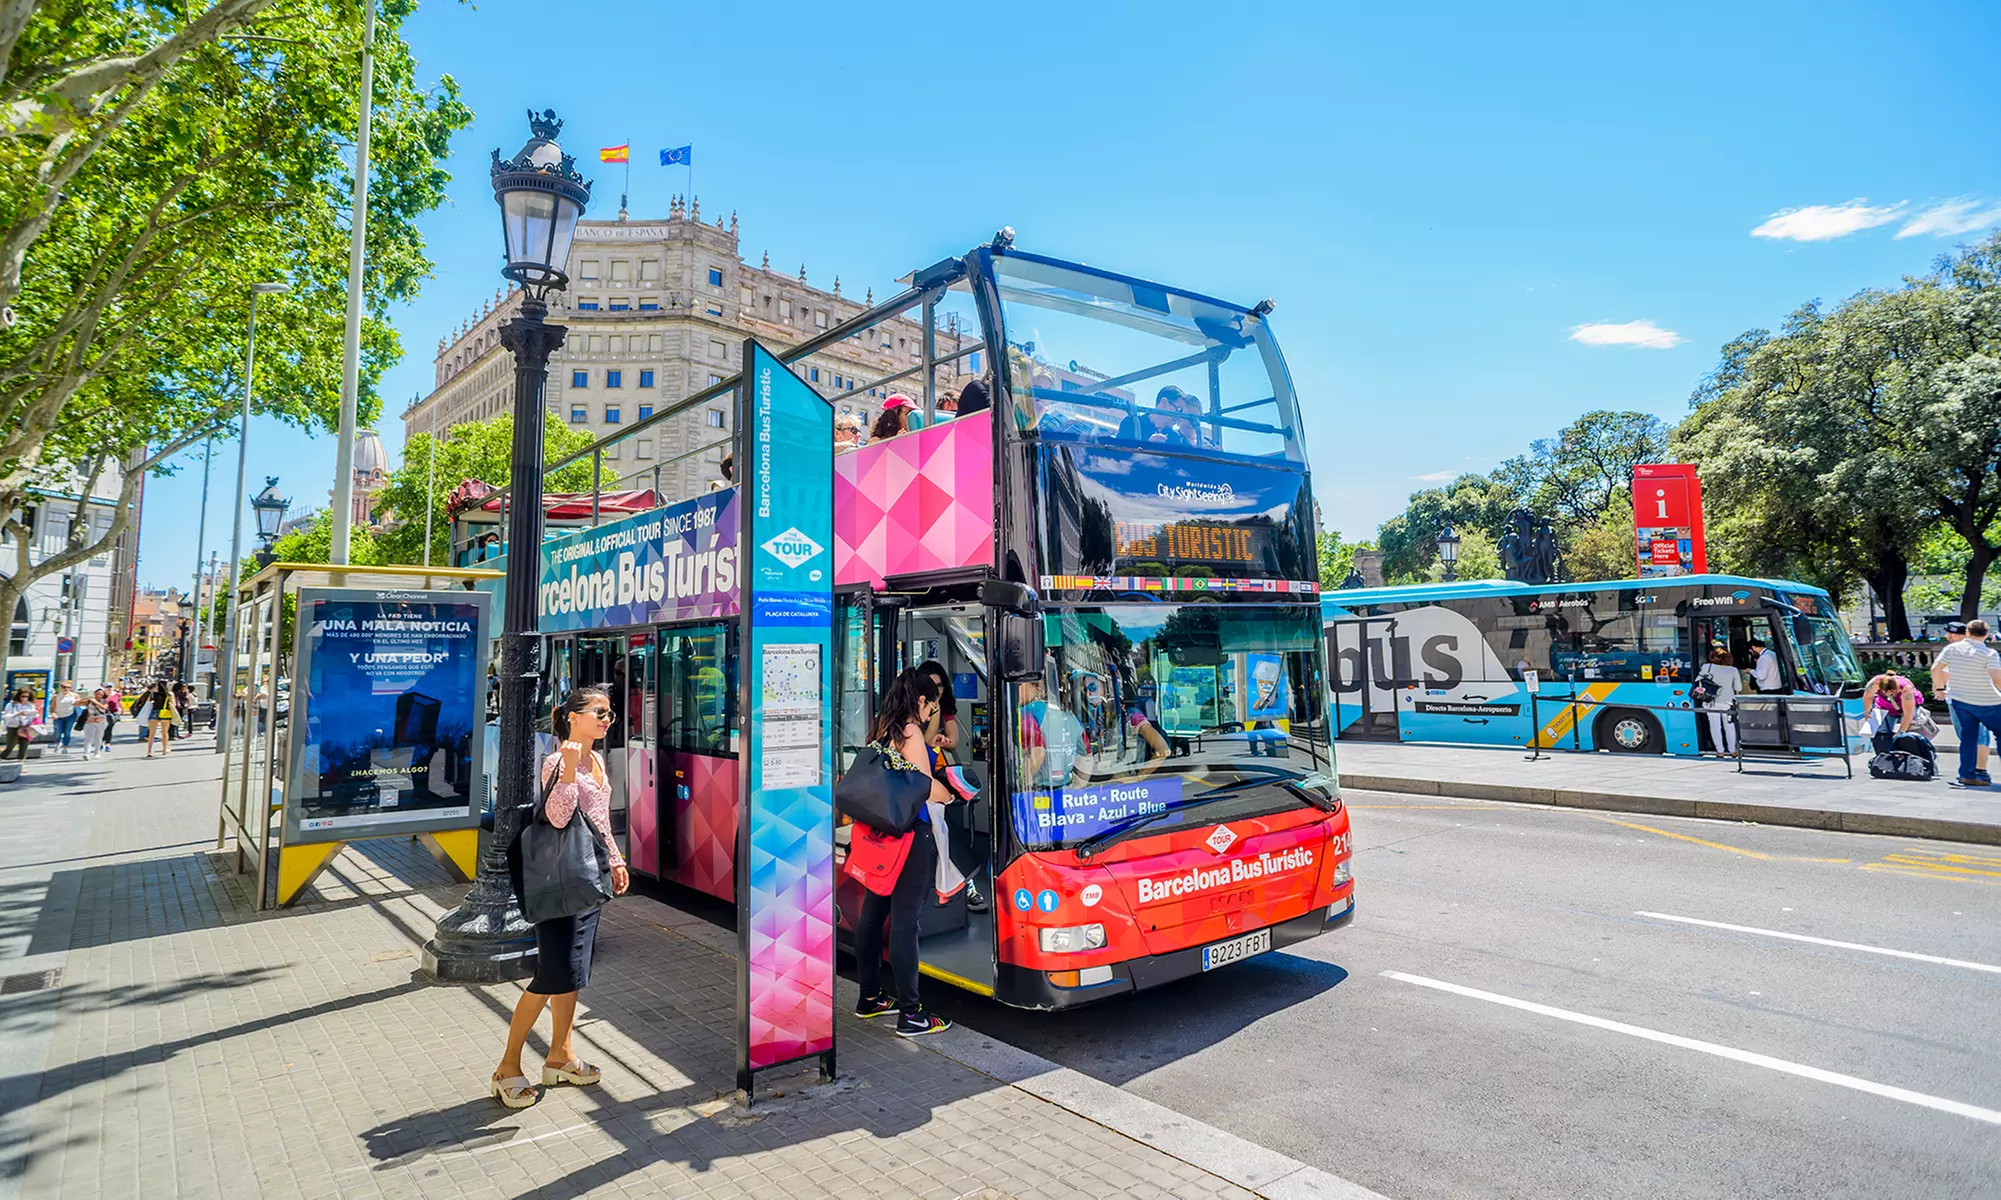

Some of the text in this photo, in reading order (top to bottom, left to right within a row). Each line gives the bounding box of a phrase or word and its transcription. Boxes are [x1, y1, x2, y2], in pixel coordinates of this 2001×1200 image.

[577, 228, 613, 237] BANCO
[759, 445, 771, 518] Barcelona
[1186, 481, 1217, 490] Worldwide
[550, 506, 717, 565] THE ORIGINAL & OFFICIAL TOUR SINCE 1987
[1115, 521, 1253, 561] BUS TURISTIC
[773, 541, 812, 556] TOUR
[385, 592, 402, 600] Clear
[538, 564, 615, 617] rcelona
[1538, 600, 1556, 608] AMB
[1693, 597, 1714, 606] Free
[323, 619, 471, 632] UNA MALA NOTICIA
[349, 652, 360, 663] Y
[364, 652, 398, 663] UNA
[1425, 704, 1513, 714] Directo Barcelona-Aeropuerto
[350, 765, 428, 777] ¿HACEMOS ALGO?
[1062, 793, 1098, 809] Ruta
[1110, 787, 1149, 803] Route
[1038, 812, 1085, 828] Blava
[1098, 804, 1127, 821] Azul
[1138, 801, 1166, 815] Blue
[1212, 834, 1232, 845] TOUR
[1137, 846, 1314, 904] Barcelona BusTurístic
[1211, 932, 1267, 965] 9223 FBT
